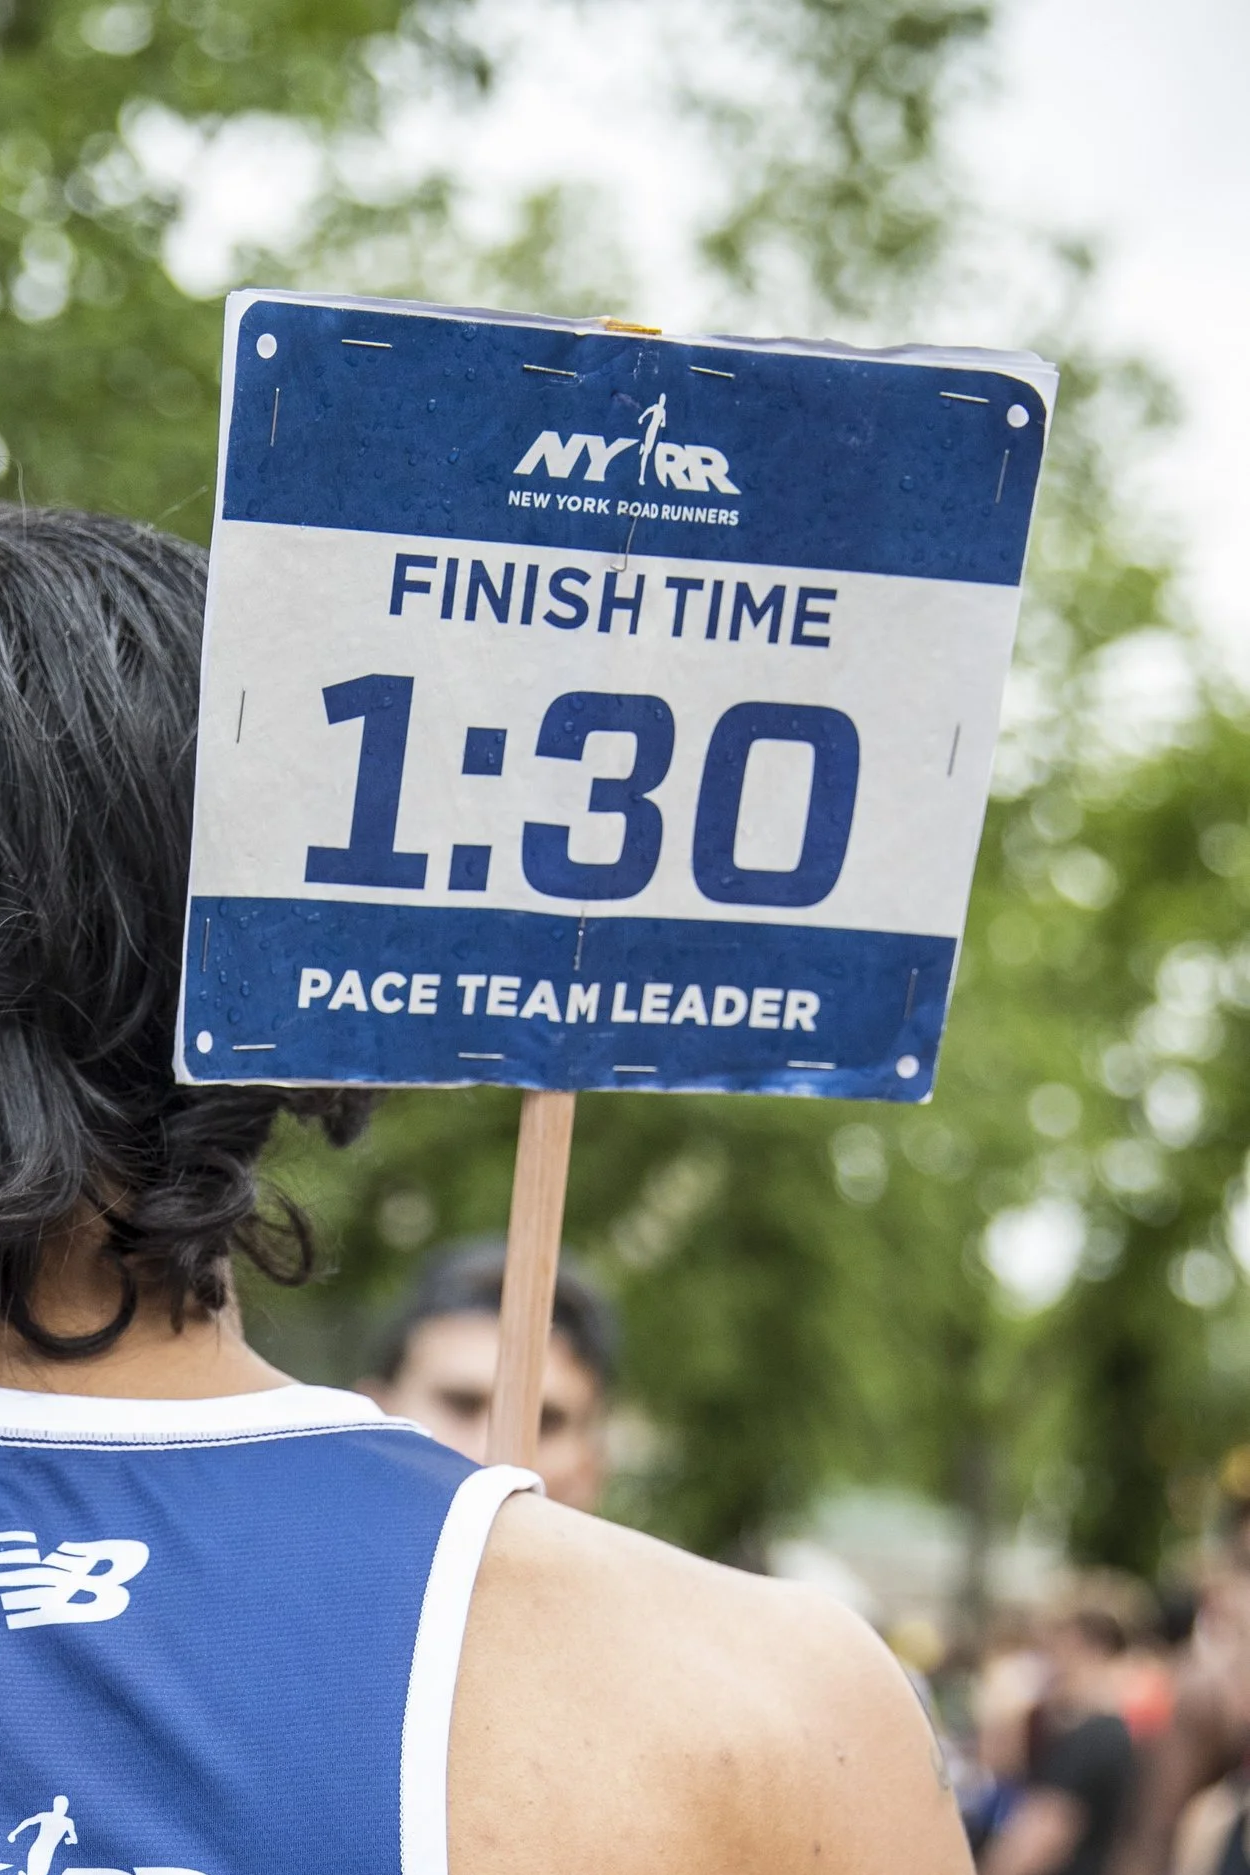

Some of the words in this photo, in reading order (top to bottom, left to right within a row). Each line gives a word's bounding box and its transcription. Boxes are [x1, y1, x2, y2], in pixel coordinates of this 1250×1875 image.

[507, 490, 551, 509] NEW
[556, 494, 610, 515] YORK
[617, 500, 659, 519] ROAD
[661, 503, 740, 527] RUNNERS
[389, 552, 646, 636] FINISH
[664, 575, 838, 648] TIME
[303, 672, 861, 908] 1:30
[297, 967, 441, 1015] PACE
[456, 974, 603, 1024] TEAM
[610, 982, 821, 1032] LEADER
